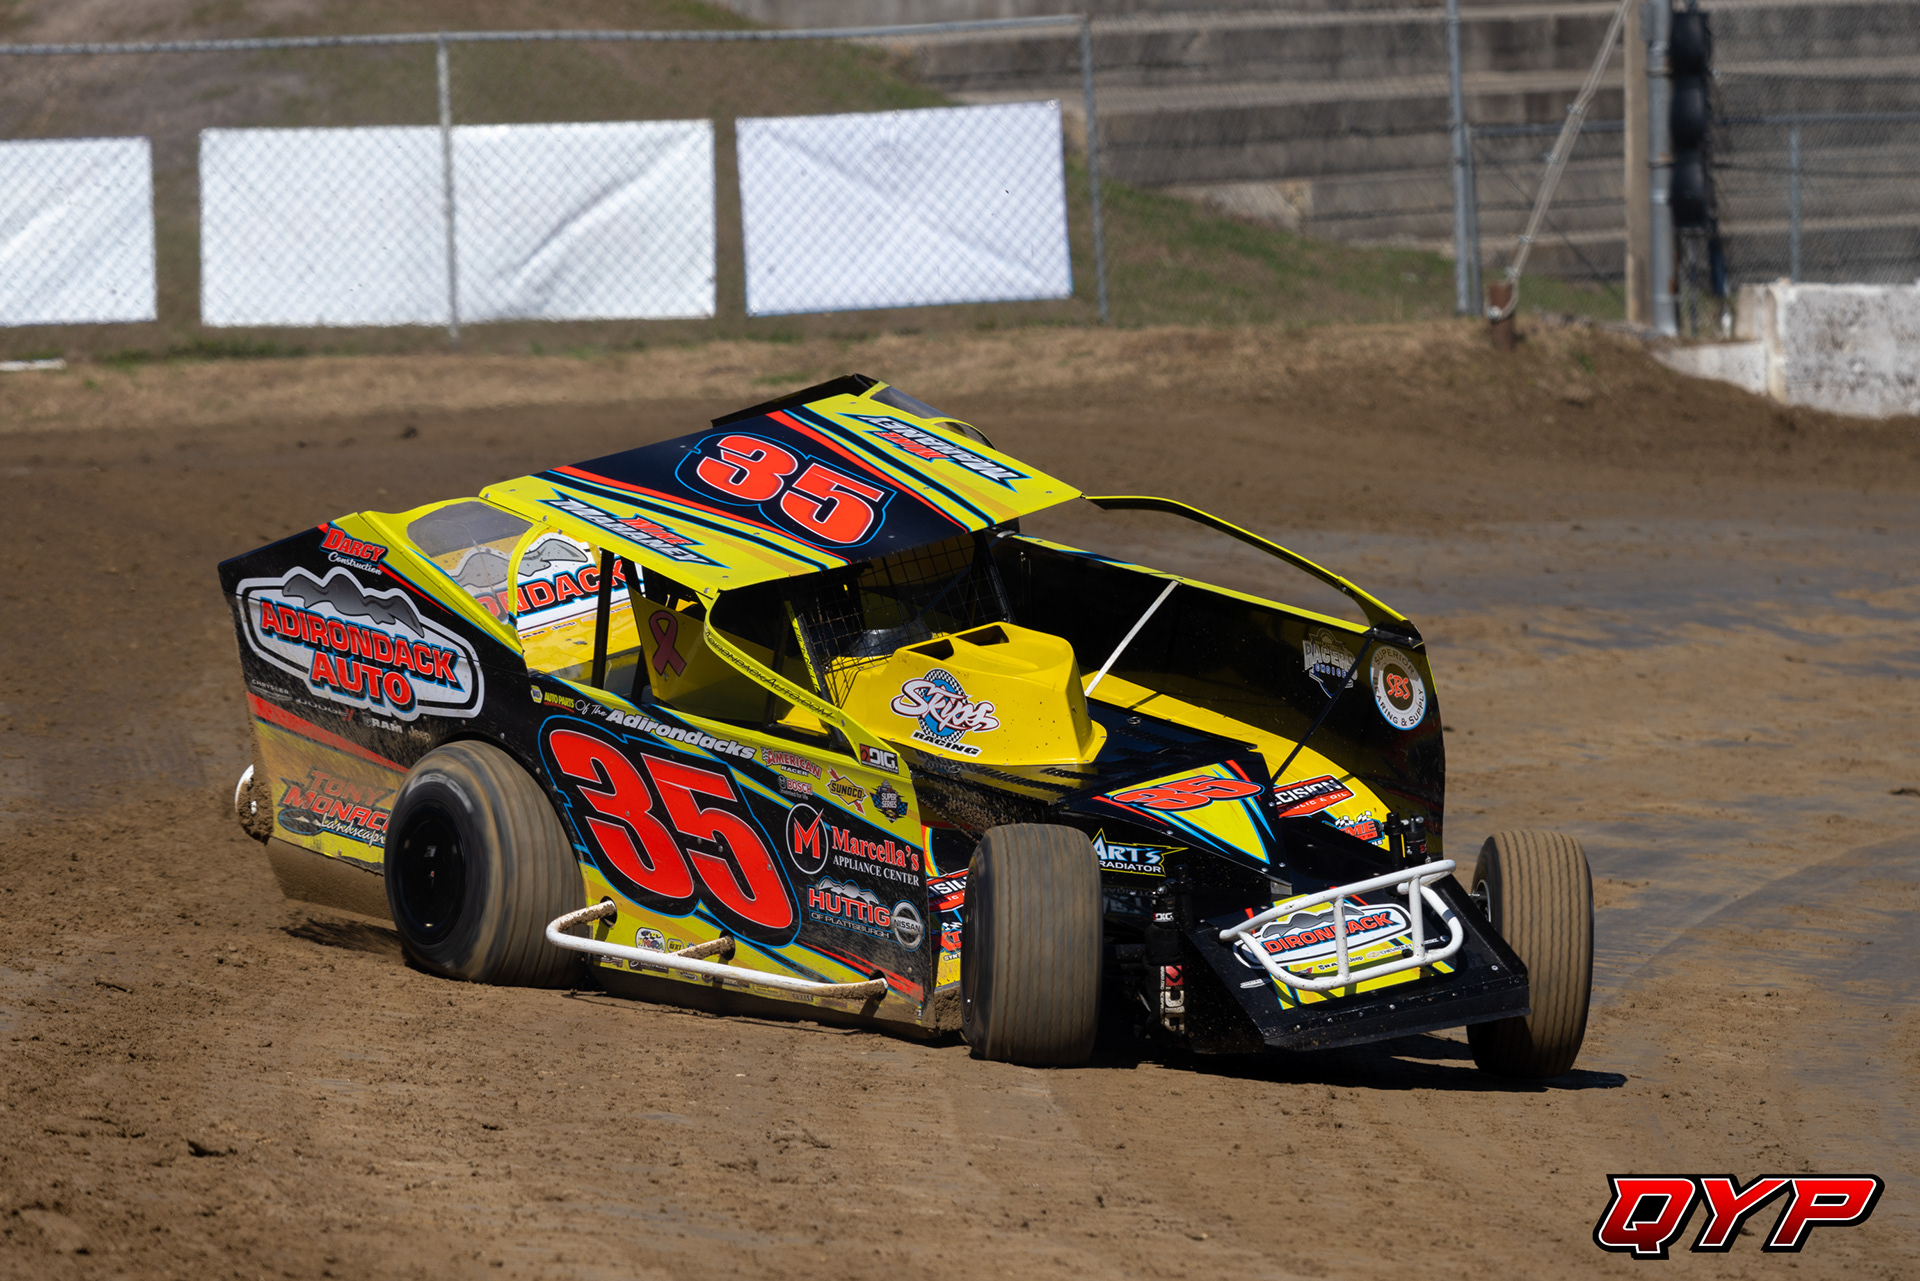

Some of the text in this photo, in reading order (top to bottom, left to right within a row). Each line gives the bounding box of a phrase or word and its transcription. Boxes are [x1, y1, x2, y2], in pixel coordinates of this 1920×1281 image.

[696, 435, 885, 543] 35
[321, 528, 385, 562] DARCY
[328, 552, 382, 575] Construction
[476, 560, 626, 618] ONDACK
[260, 600, 457, 683] ADIRONDACK
[1374, 648, 1415, 674] SUPERIOR
[311, 651, 412, 704] AUTO
[1387, 674, 1410, 700] SBS
[1401, 717, 1407, 727] &
[1408, 688, 1424, 725] SUPPLY
[371, 717, 403, 734] RAM
[544, 691, 559, 704] AUTO
[558, 695, 575, 709] PARTS
[575, 699, 591, 715] Of
[591, 704, 608, 717] The
[605, 709, 757, 760] Adirondacks
[913, 731, 979, 755] RACING
[766, 750, 822, 780] AMERICAN
[781, 765, 809, 777] RACER
[310, 770, 385, 807] TONY
[787, 779, 814, 796] BOSCH
[830, 782, 863, 800] SUNOCO
[881, 792, 897, 801] SUPER
[1114, 776, 1263, 811] 35
[1275, 780, 1342, 805] CISION
[1330, 792, 1348, 800] OIL
[282, 785, 389, 831] MONAC
[881, 800, 897, 809] SERIES
[321, 812, 386, 848] Landscapi
[550, 728, 794, 929] 35
[831, 825, 919, 872] Marcella's
[833, 855, 919, 887] APPLIANCE CENTER
[1099, 860, 1162, 873] RADIATOR
[808, 888, 890, 927] HUTTIG
[811, 912, 890, 939] OF PLATTSBURGH
[893, 919, 922, 931] NISSAN
[1263, 913, 1394, 954] DIRONACK
